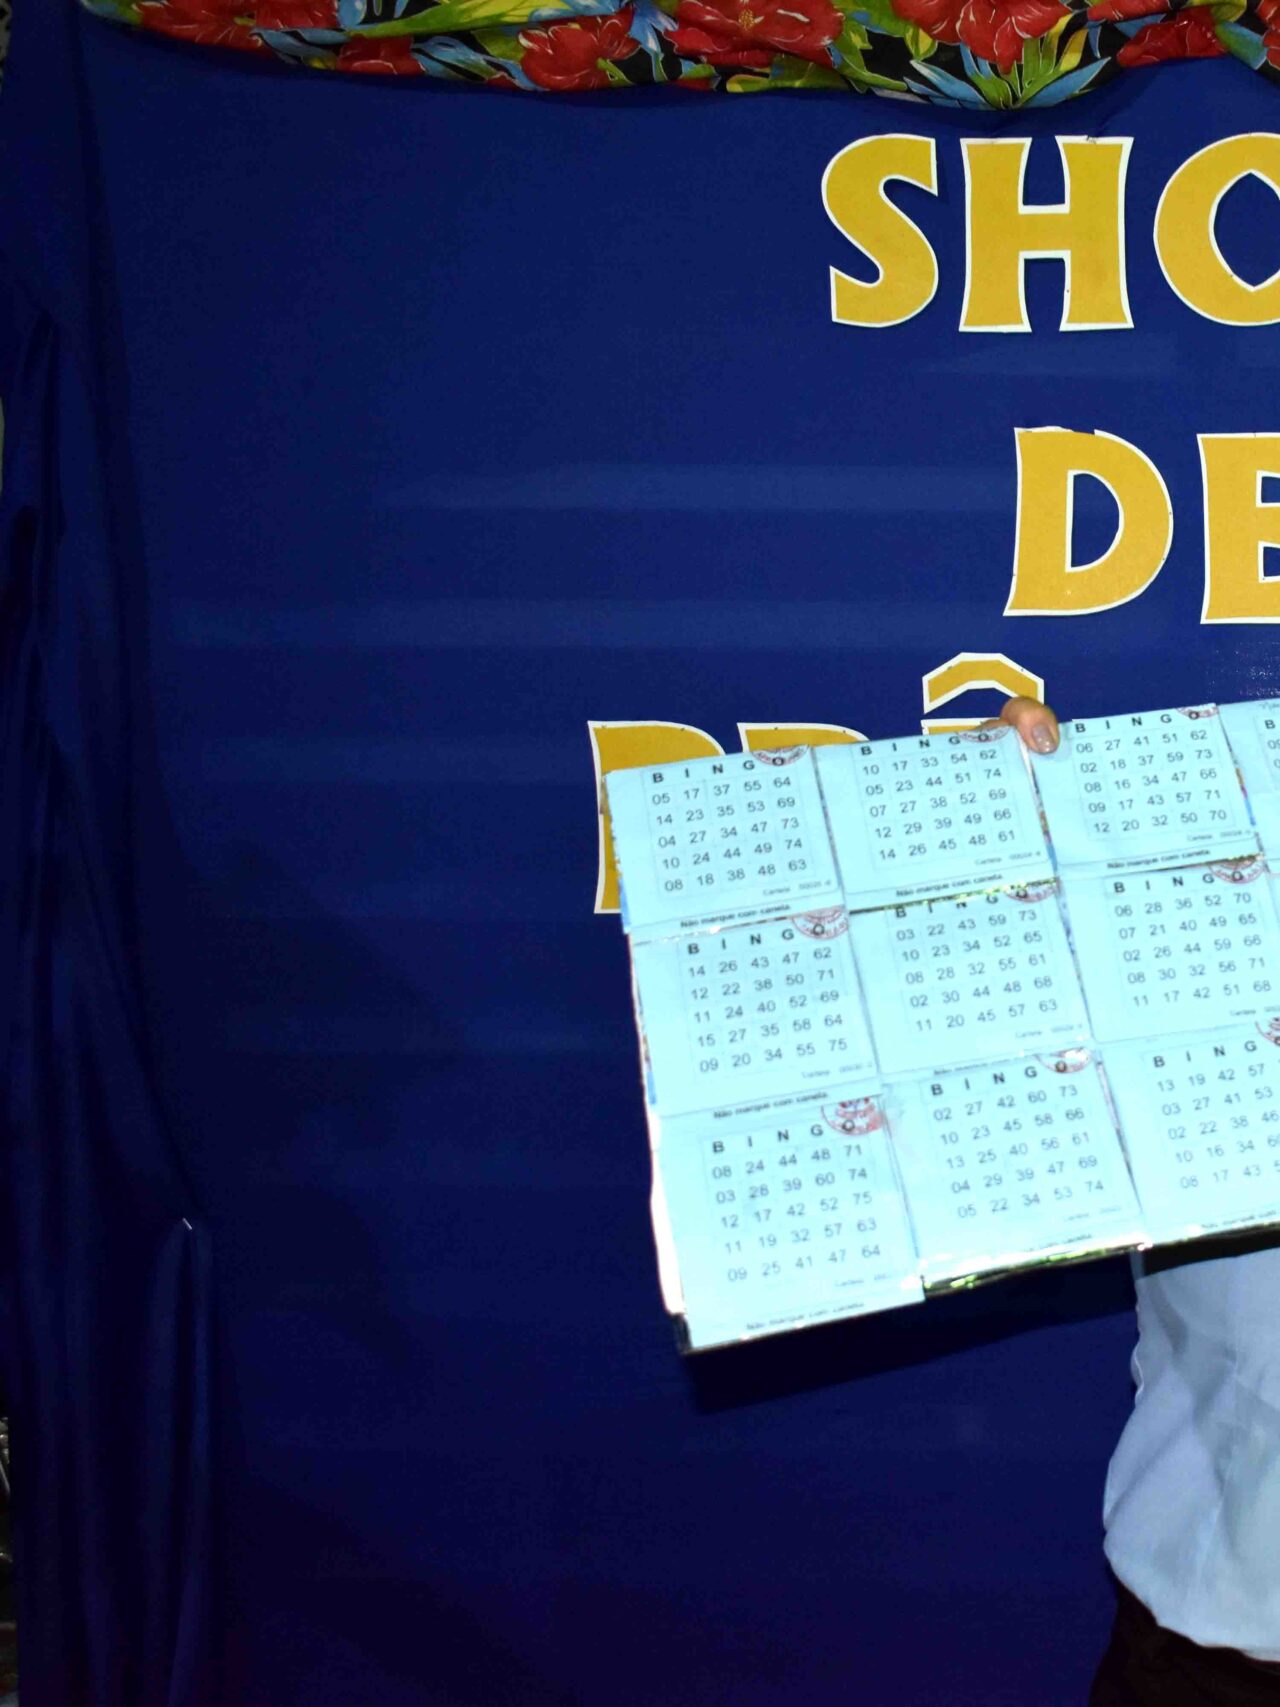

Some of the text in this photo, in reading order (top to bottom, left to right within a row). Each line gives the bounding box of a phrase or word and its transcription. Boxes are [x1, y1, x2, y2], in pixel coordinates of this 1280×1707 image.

[1104, 738, 1121, 752] 27
[1133, 735, 1150, 747] 41
[1161, 732, 1178, 744] 51
[862, 764, 880, 776] 10
[891, 759, 909, 772] 17
[919, 756, 940, 769] 33
[949, 752, 968, 765] 54
[1079, 761, 1098, 774] 02
[1137, 753, 1155, 767] 37
[1166, 751, 1185, 764] 59
[1194, 748, 1214, 760] 73
[651, 792, 671, 806] 05
[683, 787, 701, 800] 17
[713, 783, 731, 797] 37
[743, 779, 762, 793] 55
[865, 767, 1002, 797] 05 23 44 51 74
[656, 813, 673, 826] 14
[685, 808, 705, 823] 23
[716, 804, 736, 818] 35
[746, 799, 766, 813] 53
[868, 804, 887, 819] 07
[899, 799, 917, 815] 27
[959, 791, 977, 805] 52
[657, 816, 800, 849] 04 27 34 47 73
[1233, 891, 1252, 904] 70
[895, 908, 1038, 942] 03 22 43 59 73
[1117, 926, 1137, 941] 07
[1148, 923, 1167, 937] 21
[1178, 919, 1198, 932] 40
[1208, 915, 1228, 928] 49
[901, 948, 921, 962] 10
[931, 943, 951, 959] 23
[962, 939, 981, 953] 34
[993, 934, 1012, 948] 52
[688, 965, 706, 978] 14
[781, 951, 800, 965] 47
[690, 986, 709, 1001] 12
[721, 982, 741, 997] 22
[816, 967, 835, 982] 71
[1187, 1073, 1206, 1087] 19
[1217, 1068, 1236, 1081] 42
[932, 1106, 953, 1122] 02
[964, 1100, 983, 1117] 27
[996, 1094, 1017, 1109] 42
[745, 1159, 765, 1176] 24
[778, 1153, 798, 1168] 44
[843, 1143, 863, 1158] 71
